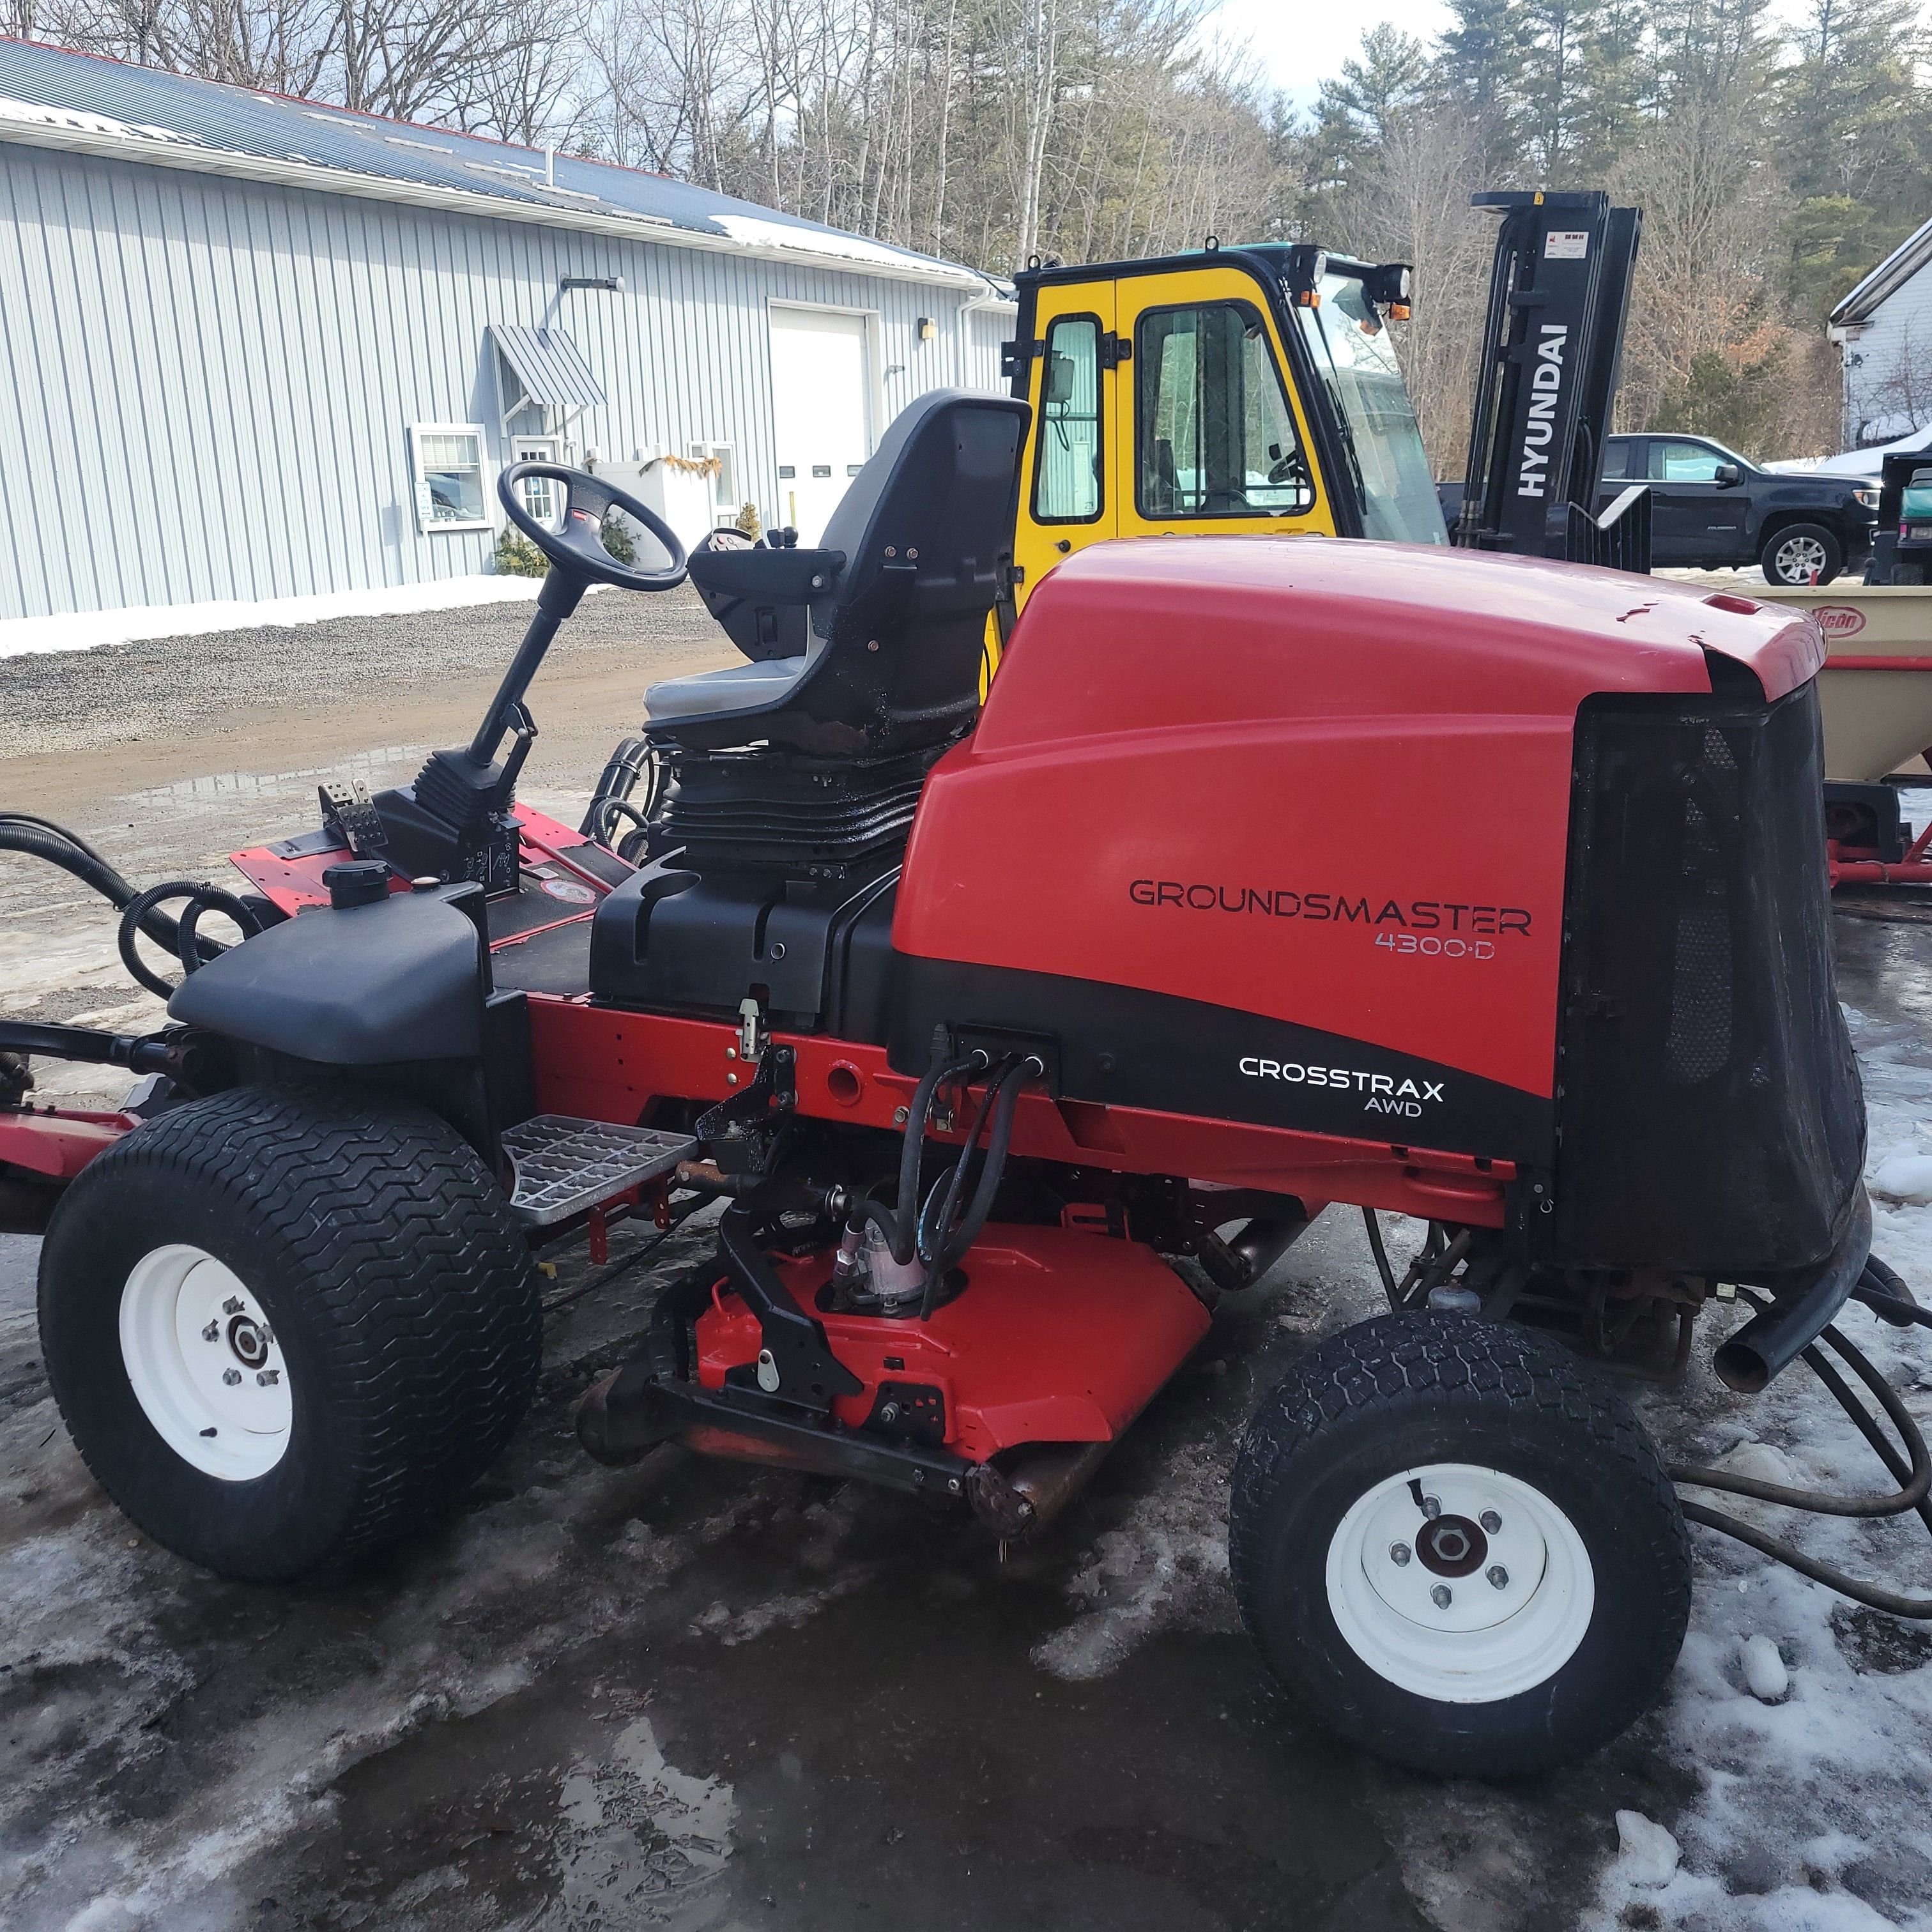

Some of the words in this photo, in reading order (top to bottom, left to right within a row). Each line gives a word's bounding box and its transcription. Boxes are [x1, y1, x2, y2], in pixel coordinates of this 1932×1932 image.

[1518, 325, 1567, 496] HYUNDAI
[1130, 879, 1531, 937] GROUNDSMASTER
[1239, 1057, 1444, 1102] CROSSTRAX
[1364, 1097, 1422, 1117] AWD
